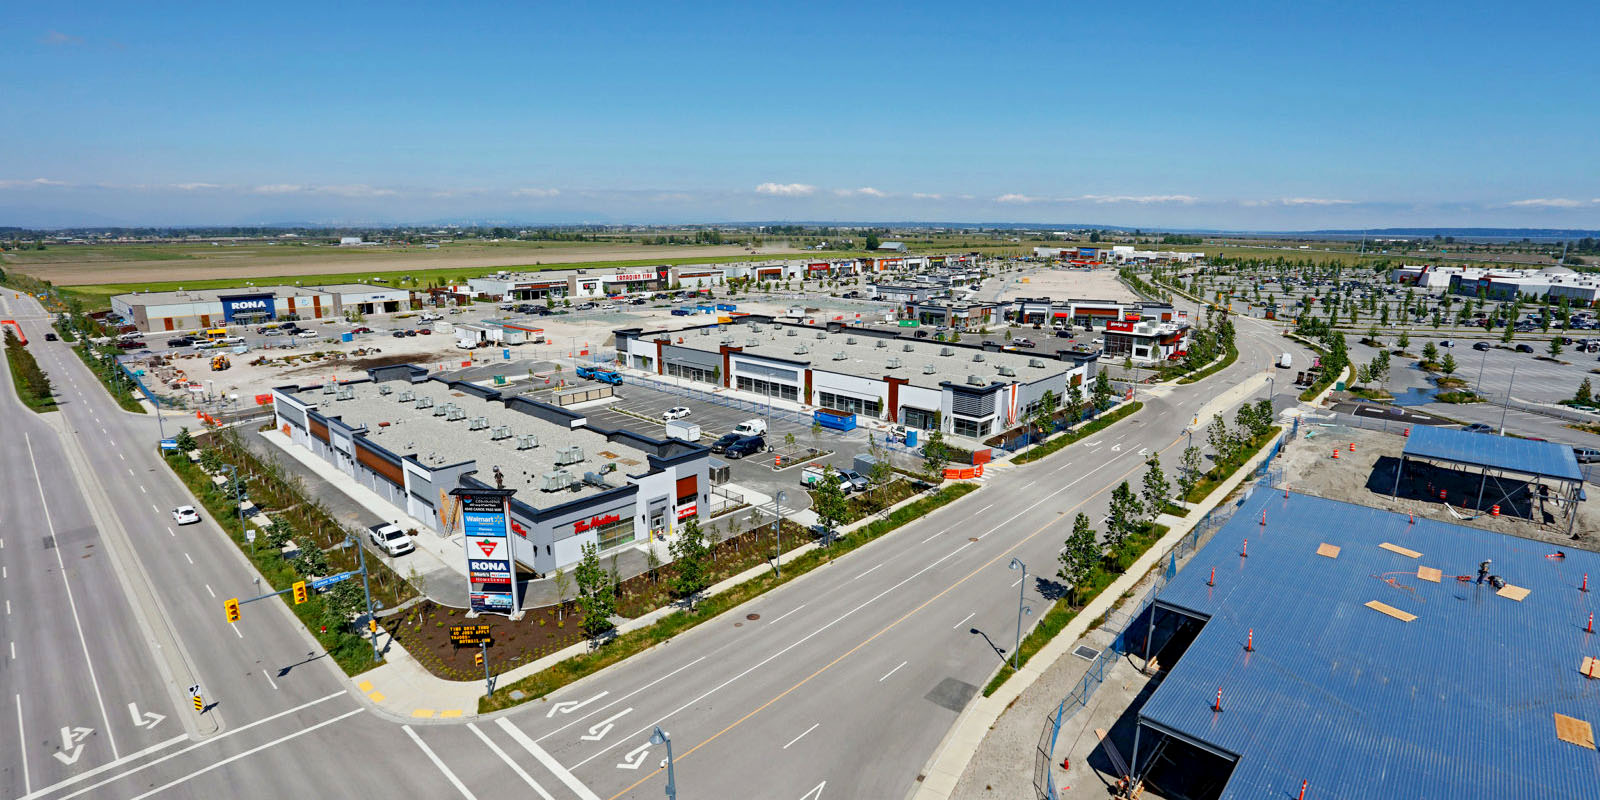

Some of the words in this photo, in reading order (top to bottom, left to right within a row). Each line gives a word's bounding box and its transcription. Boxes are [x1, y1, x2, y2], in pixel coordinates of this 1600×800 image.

[231, 300, 267, 310] RONA
[466, 515, 494, 523] Walmart
[573, 520, 590, 535] Tim
[590, 514, 620, 529] Hortons
[471, 561, 507, 571] RONA
